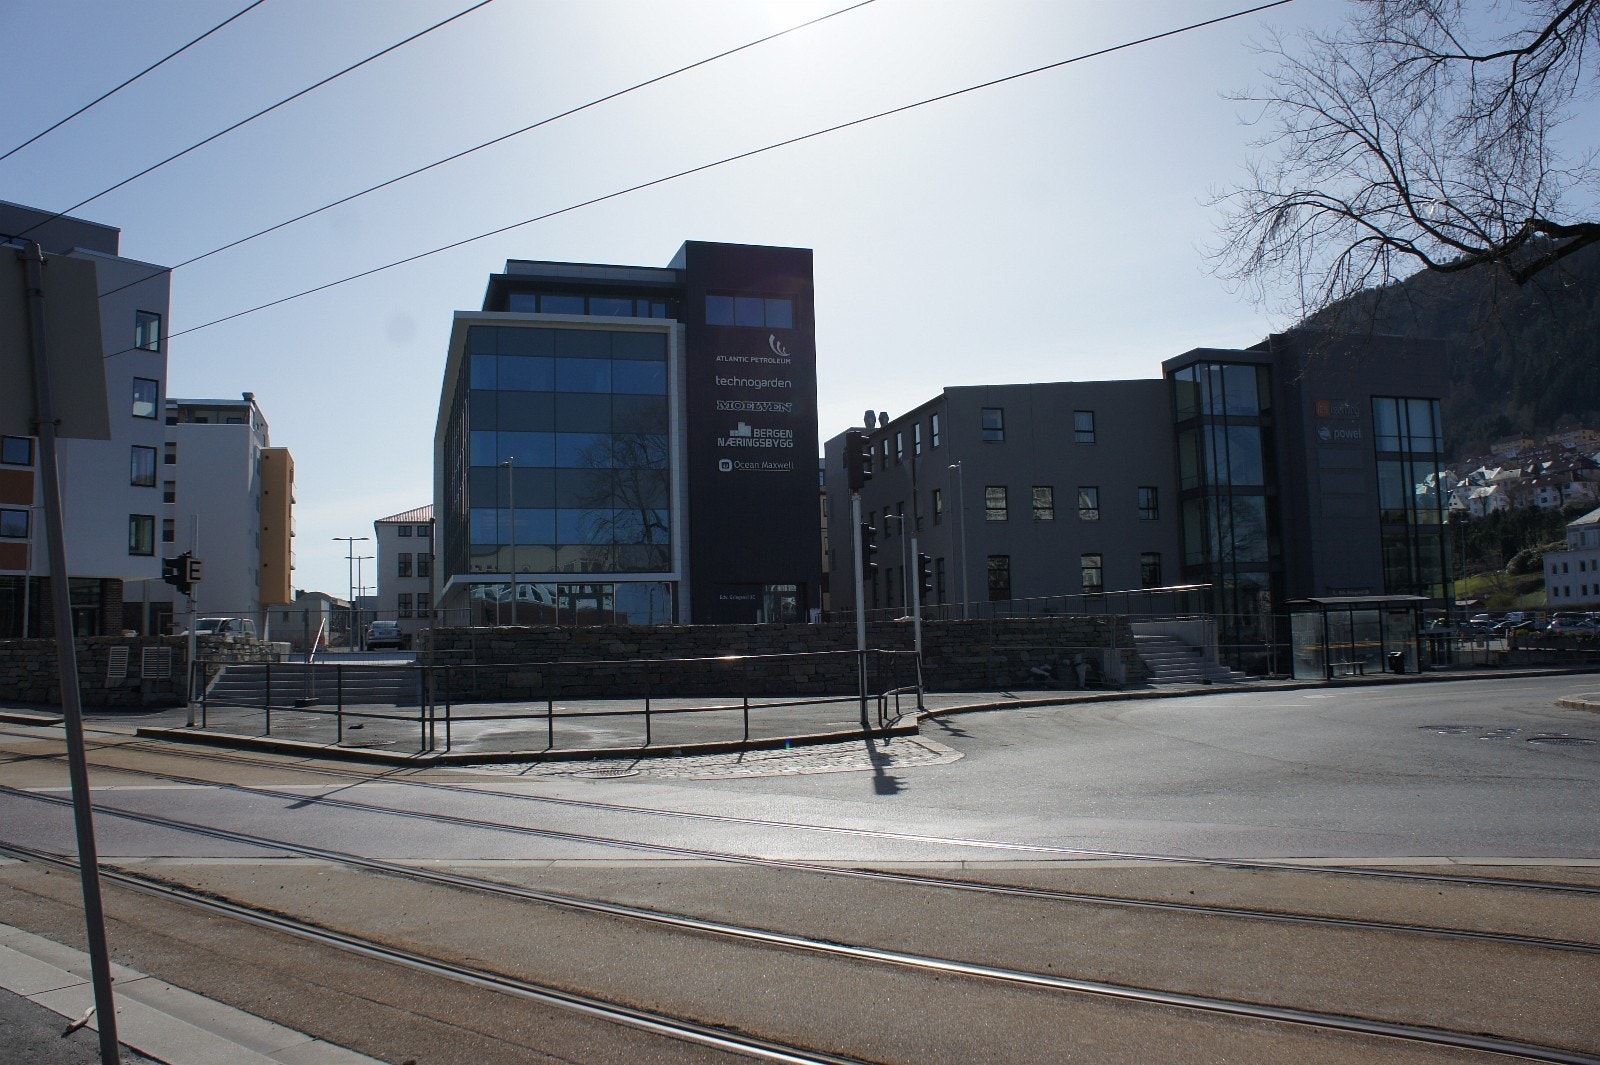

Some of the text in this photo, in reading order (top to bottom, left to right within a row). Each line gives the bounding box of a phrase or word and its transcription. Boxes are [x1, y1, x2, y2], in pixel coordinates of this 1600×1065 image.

[716, 355, 791, 365] ATLANTIC PETROLEUM
[715, 375, 792, 389] technogarden
[716, 400, 792, 412] MOELVEN
[753, 428, 793, 438] BERGEN
[1334, 428, 1361, 440] powel
[717, 438, 794, 448] NÆRINGSBYGG
[734, 460, 794, 469] Ocean Maxwell
